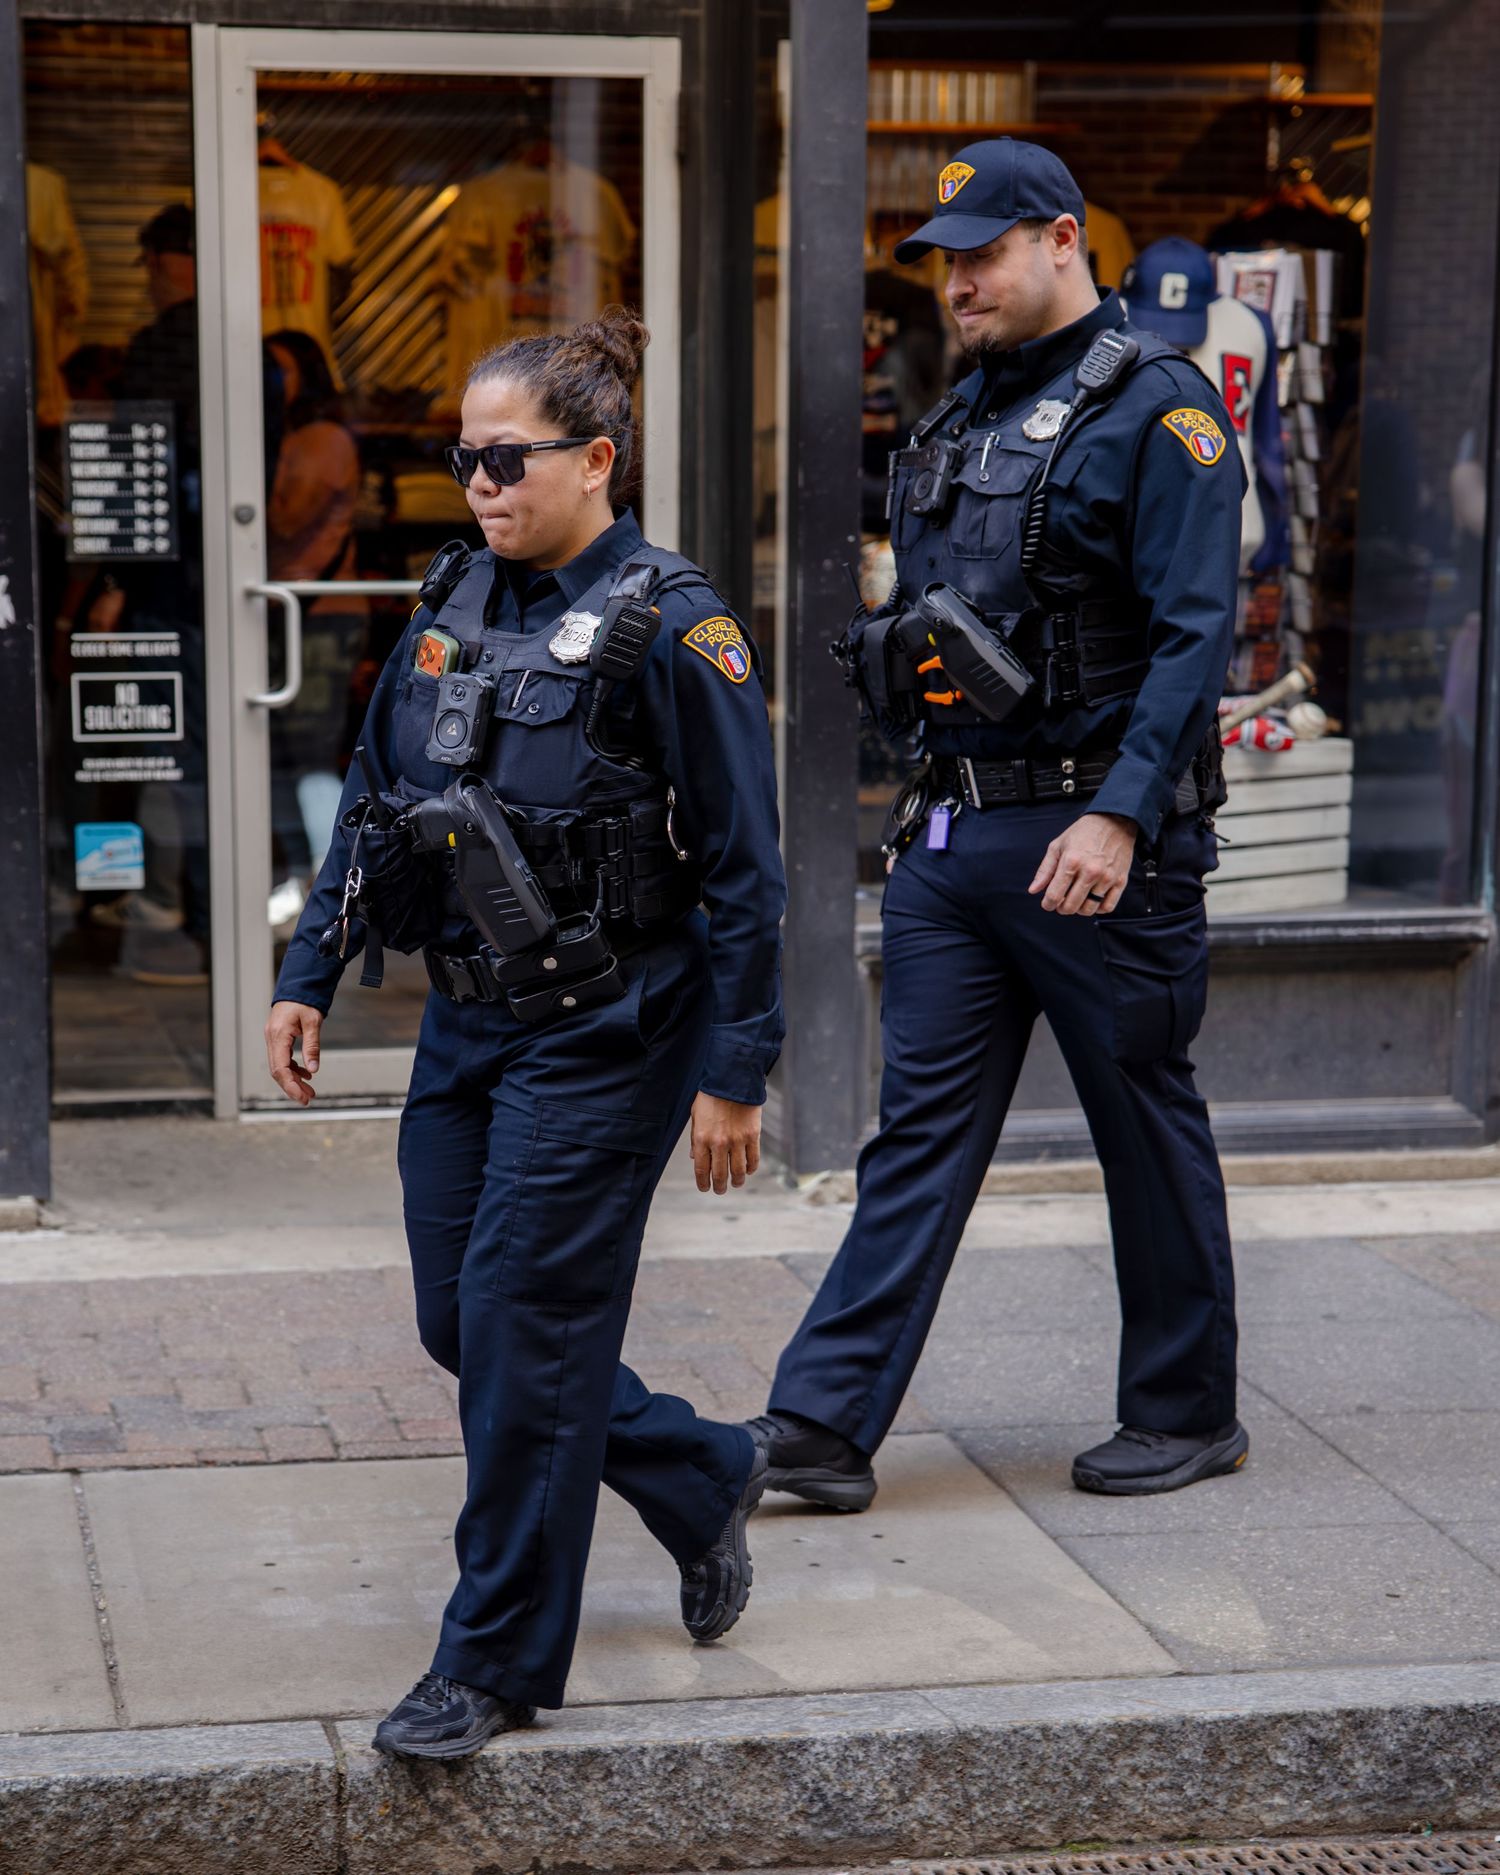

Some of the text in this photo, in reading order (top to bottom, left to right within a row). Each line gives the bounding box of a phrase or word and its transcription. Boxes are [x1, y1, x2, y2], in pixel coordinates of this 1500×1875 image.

[706, 631, 742, 648] POLICE
[115, 682, 139, 706] NO
[84, 704, 171, 731] SOLICITING
